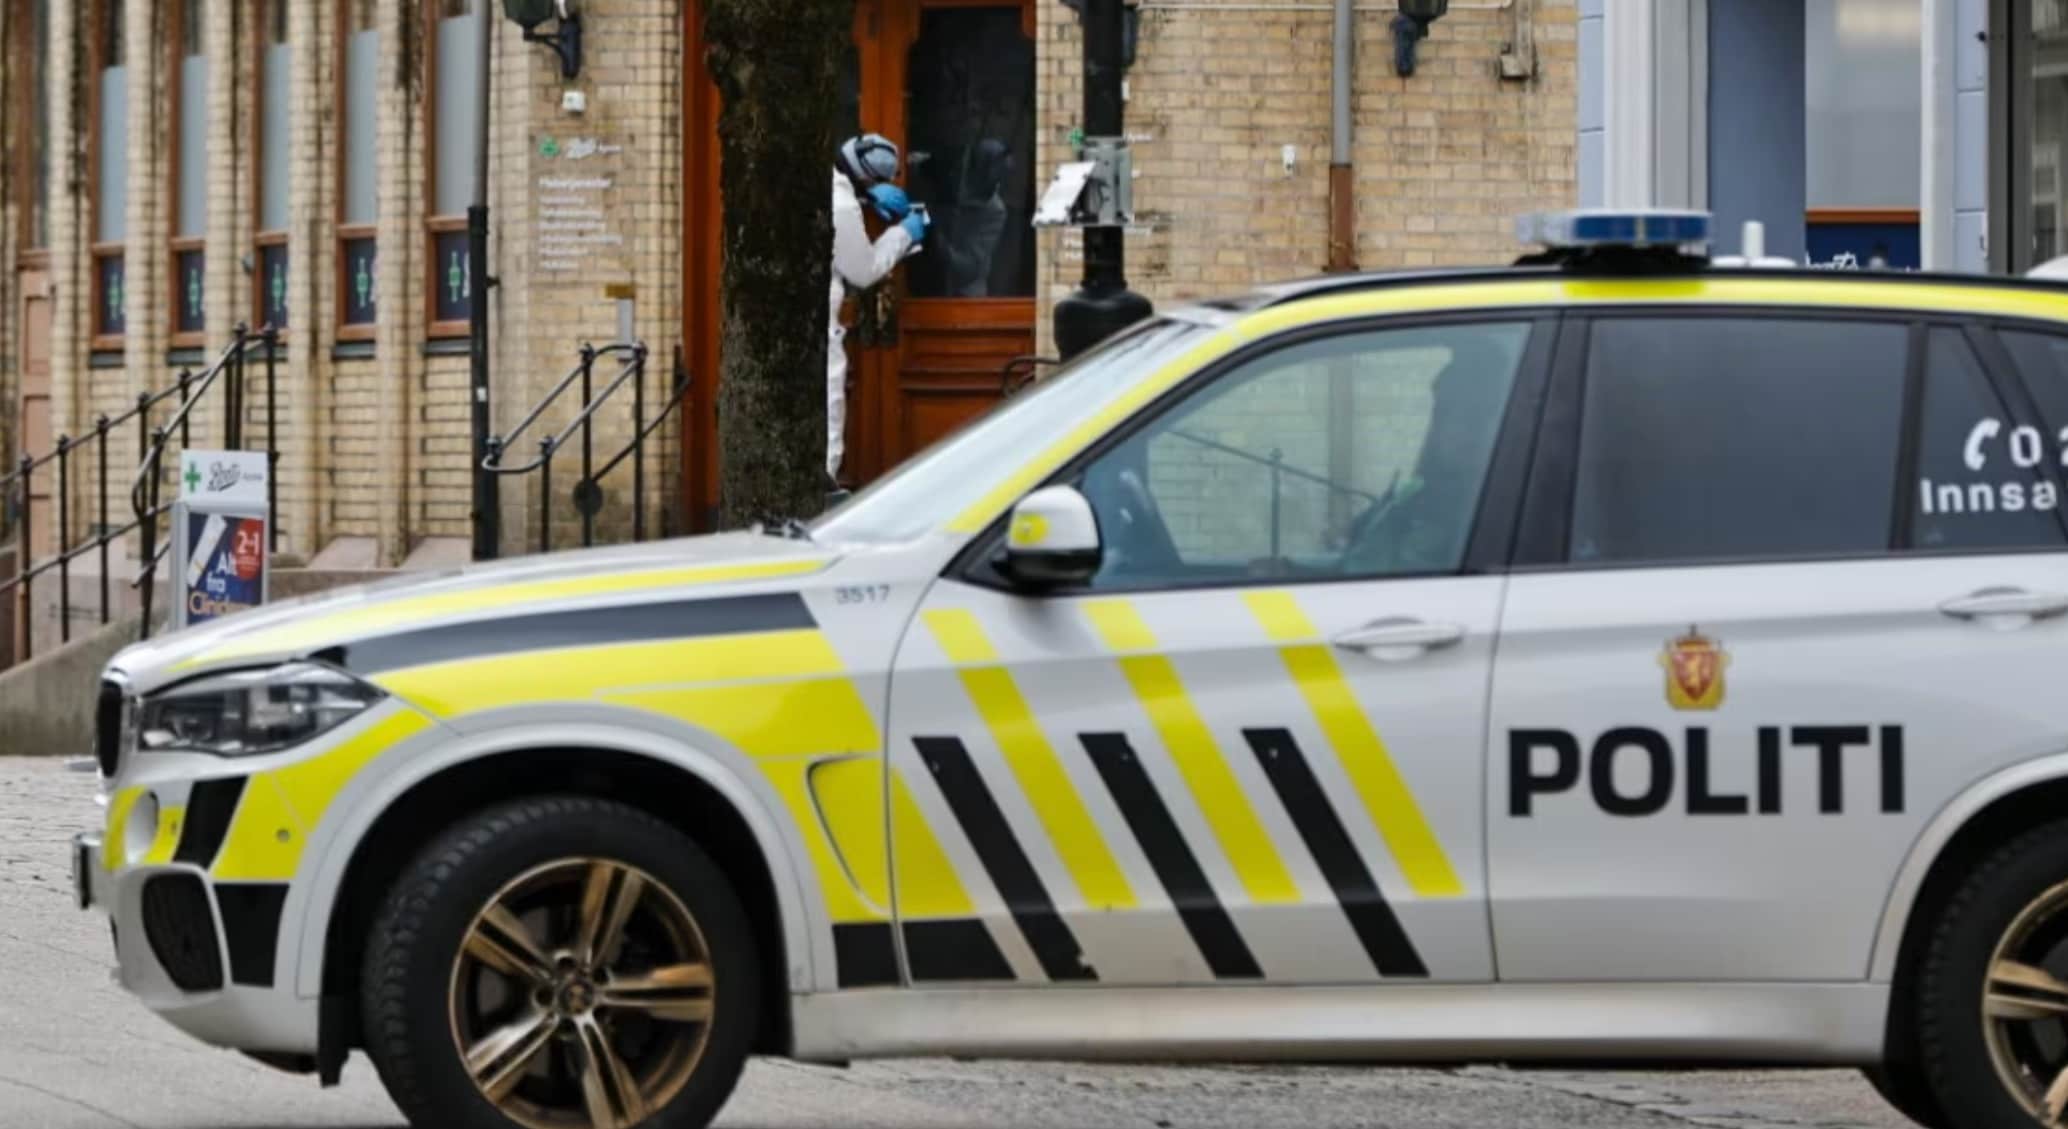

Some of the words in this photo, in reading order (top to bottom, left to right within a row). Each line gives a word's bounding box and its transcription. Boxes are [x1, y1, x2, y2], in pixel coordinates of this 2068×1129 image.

[1920, 478, 2057, 514] Innsa
[835, 584, 890, 605] 3517
[1508, 725, 1905, 817] POLITI
